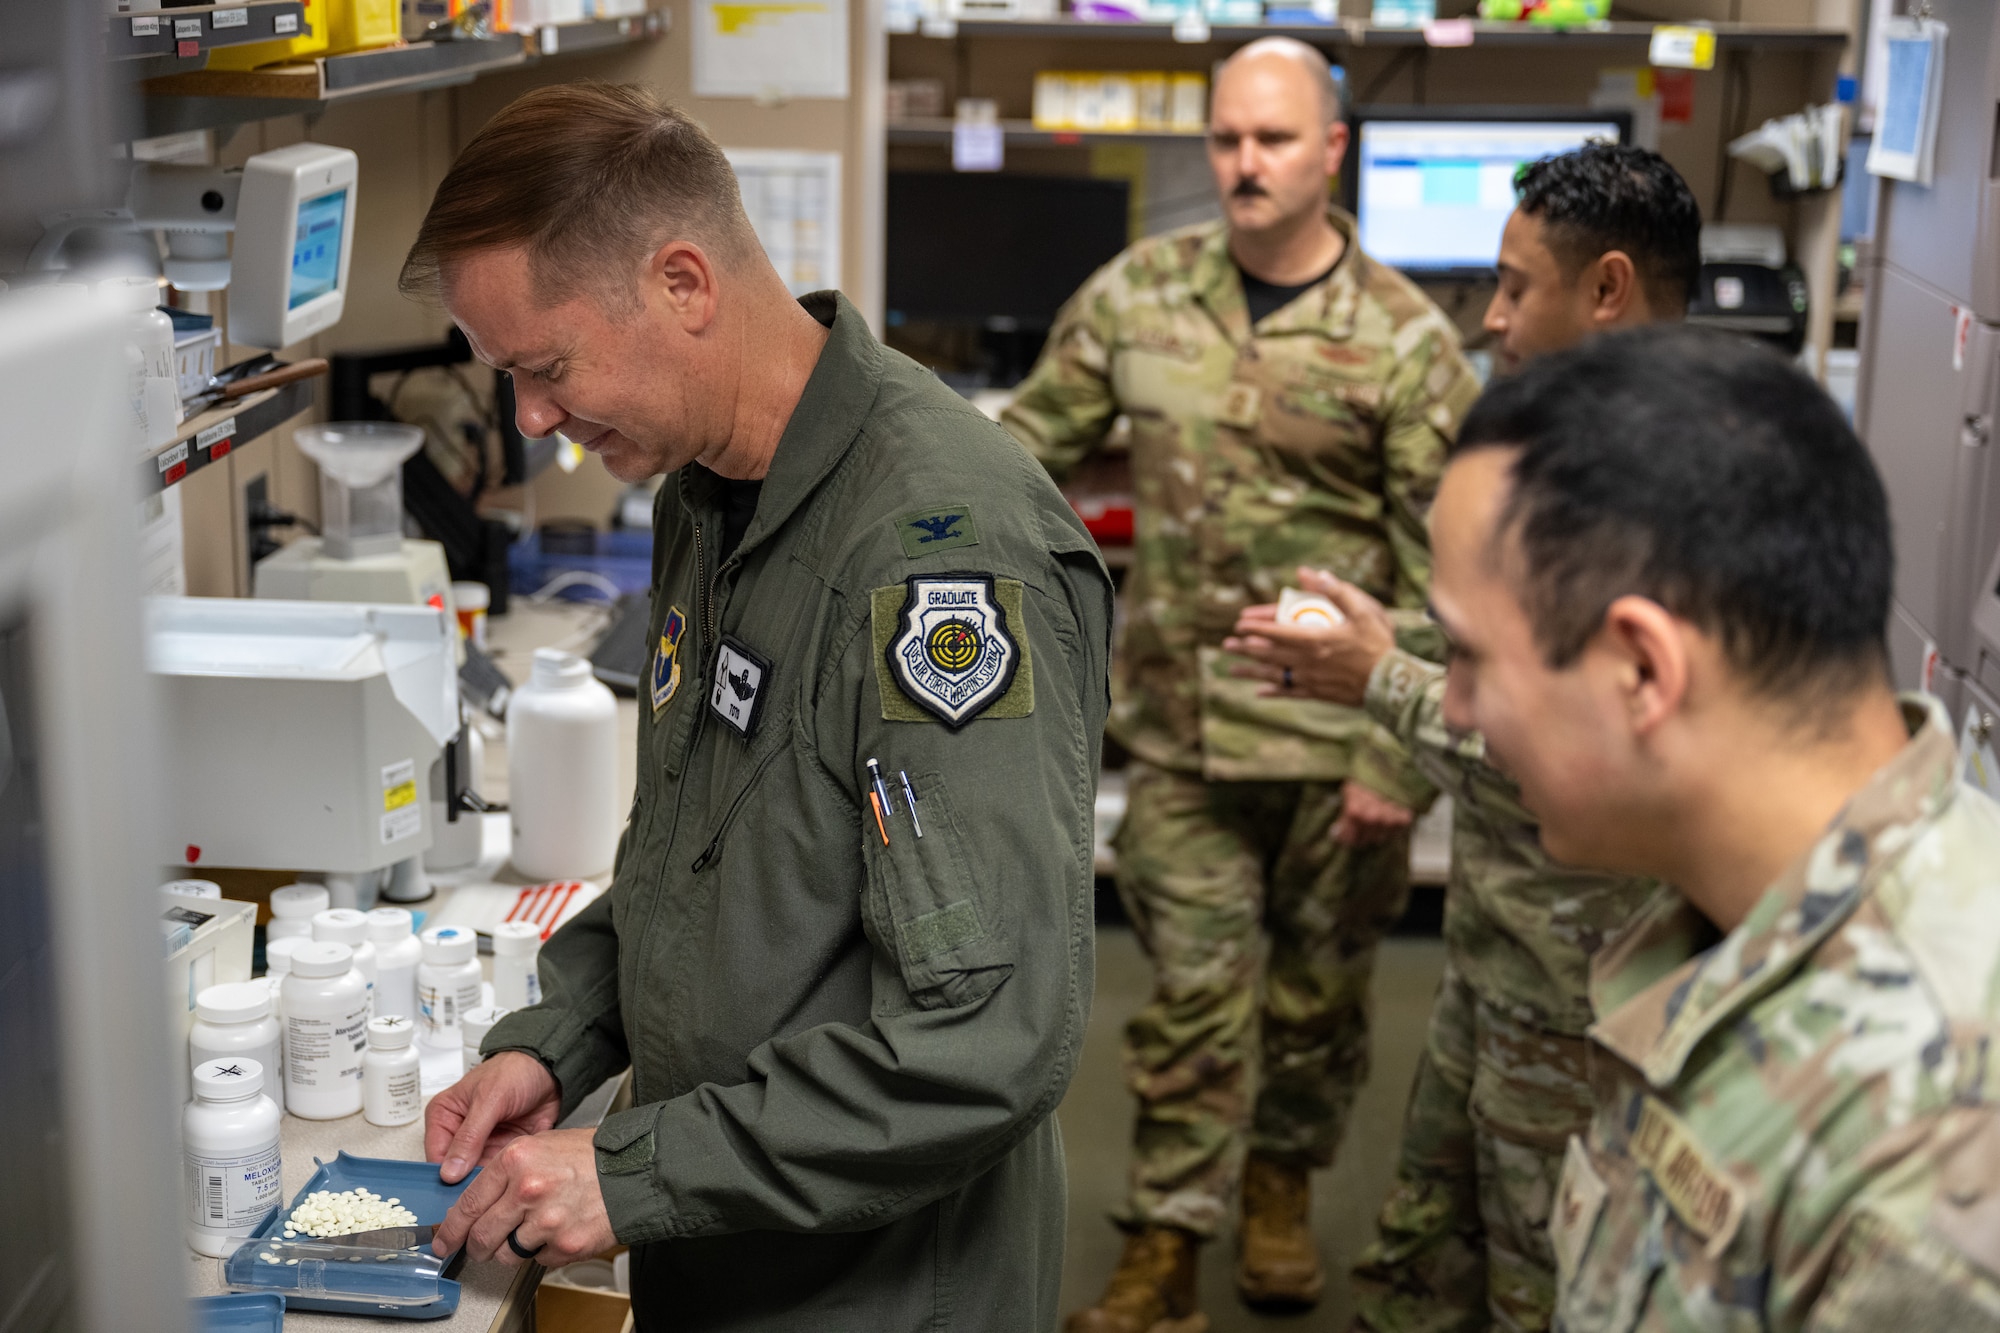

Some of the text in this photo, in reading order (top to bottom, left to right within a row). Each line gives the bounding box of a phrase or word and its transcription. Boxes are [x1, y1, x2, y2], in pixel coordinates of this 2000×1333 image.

[928, 591, 977, 605] GRADUATE
[913, 661, 929, 679] AIR
[926, 672, 950, 698] FORCE
[981, 647, 998, 680] SCHOOL
[257, 1179, 278, 1194] 7.5 mg
